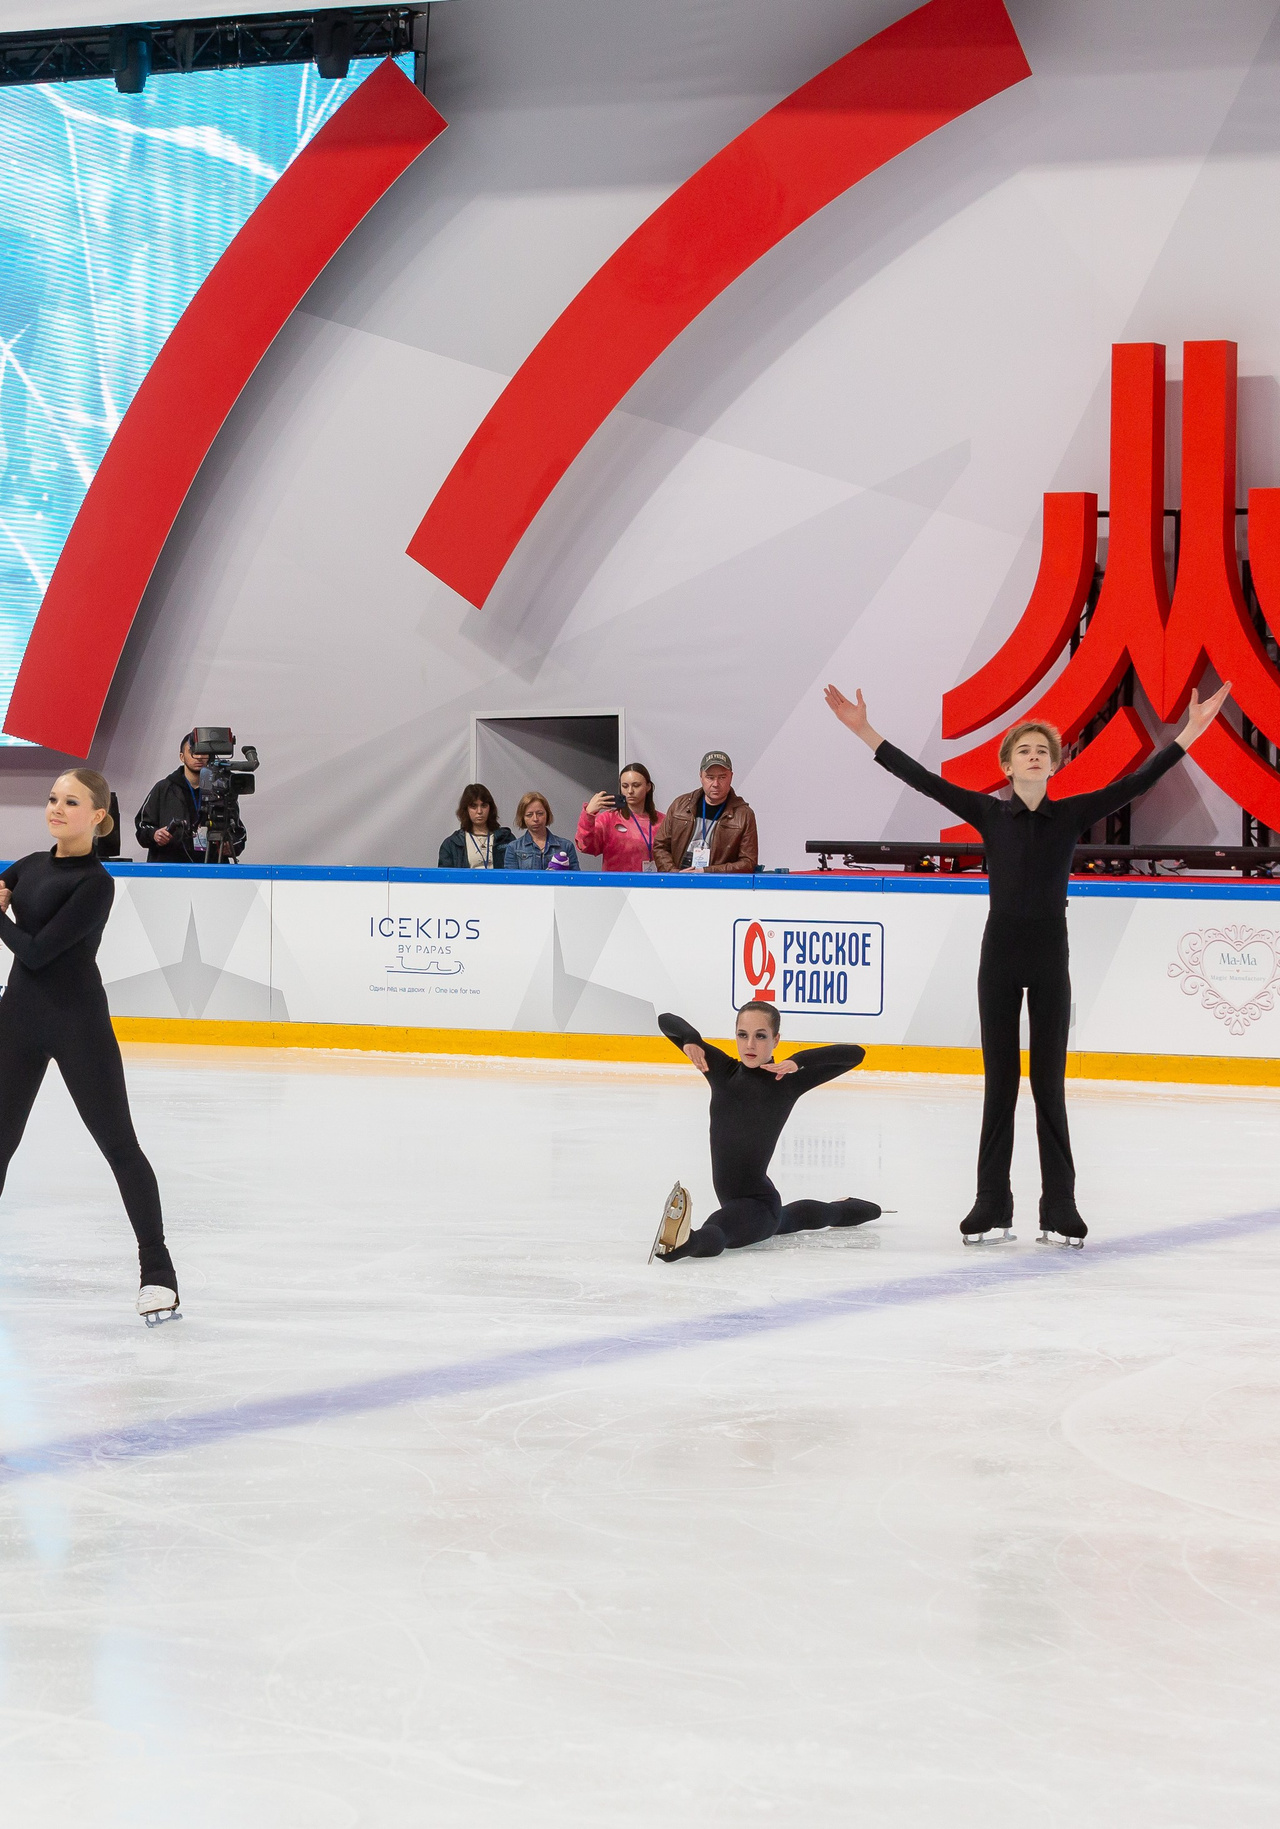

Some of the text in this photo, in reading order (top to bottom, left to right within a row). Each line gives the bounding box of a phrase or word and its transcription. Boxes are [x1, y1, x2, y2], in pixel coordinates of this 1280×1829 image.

[370, 917, 480, 939] ICEKIDS
[398, 944, 451, 955] BY PAPAS
[783, 931, 871, 966] РУССКОЕ
[1219, 953, 1257, 966] Ma-Ma
[783, 970, 847, 1004] РАДИО
